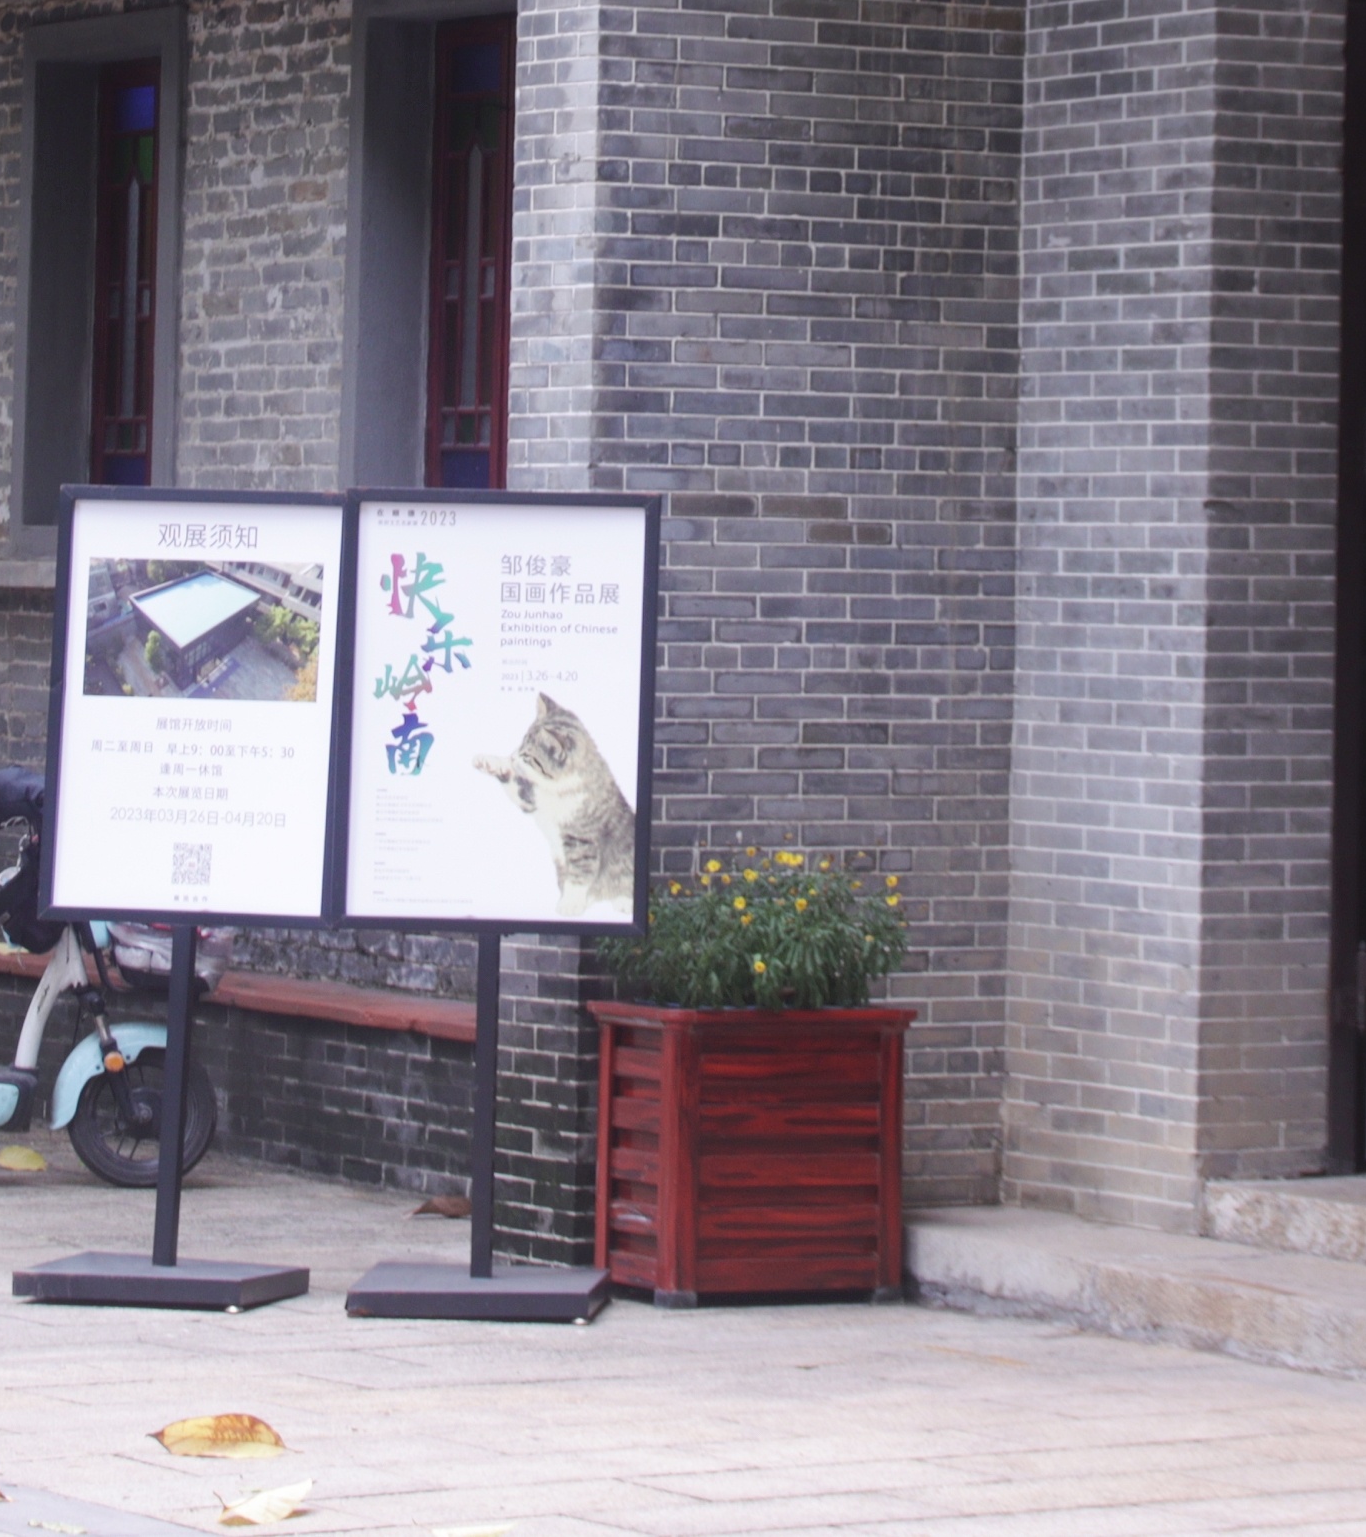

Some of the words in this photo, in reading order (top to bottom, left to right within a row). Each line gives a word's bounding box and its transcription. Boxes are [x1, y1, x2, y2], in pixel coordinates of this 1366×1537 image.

[421, 510, 457, 527] 2023
[157, 523, 258, 549] 观展须知
[501, 554, 572, 577] 邹俊豪
[501, 582, 620, 605] 国画作品展
[501, 609, 521, 620] Zou
[524, 610, 563, 620] Junhao
[501, 623, 557, 634] Exhibition
[560, 624, 572, 634] of
[575, 624, 618, 635] Chinese
[500, 637, 552, 649] paintings
[155, 717, 233, 733] 展馆开放时间
[91, 738, 154, 754] 周二至周日
[160, 762, 223, 777] 逢周一休馆
[153, 785, 229, 801] 本次展览日期
[110, 807, 287, 828] 2023年03月26日-04月20日
